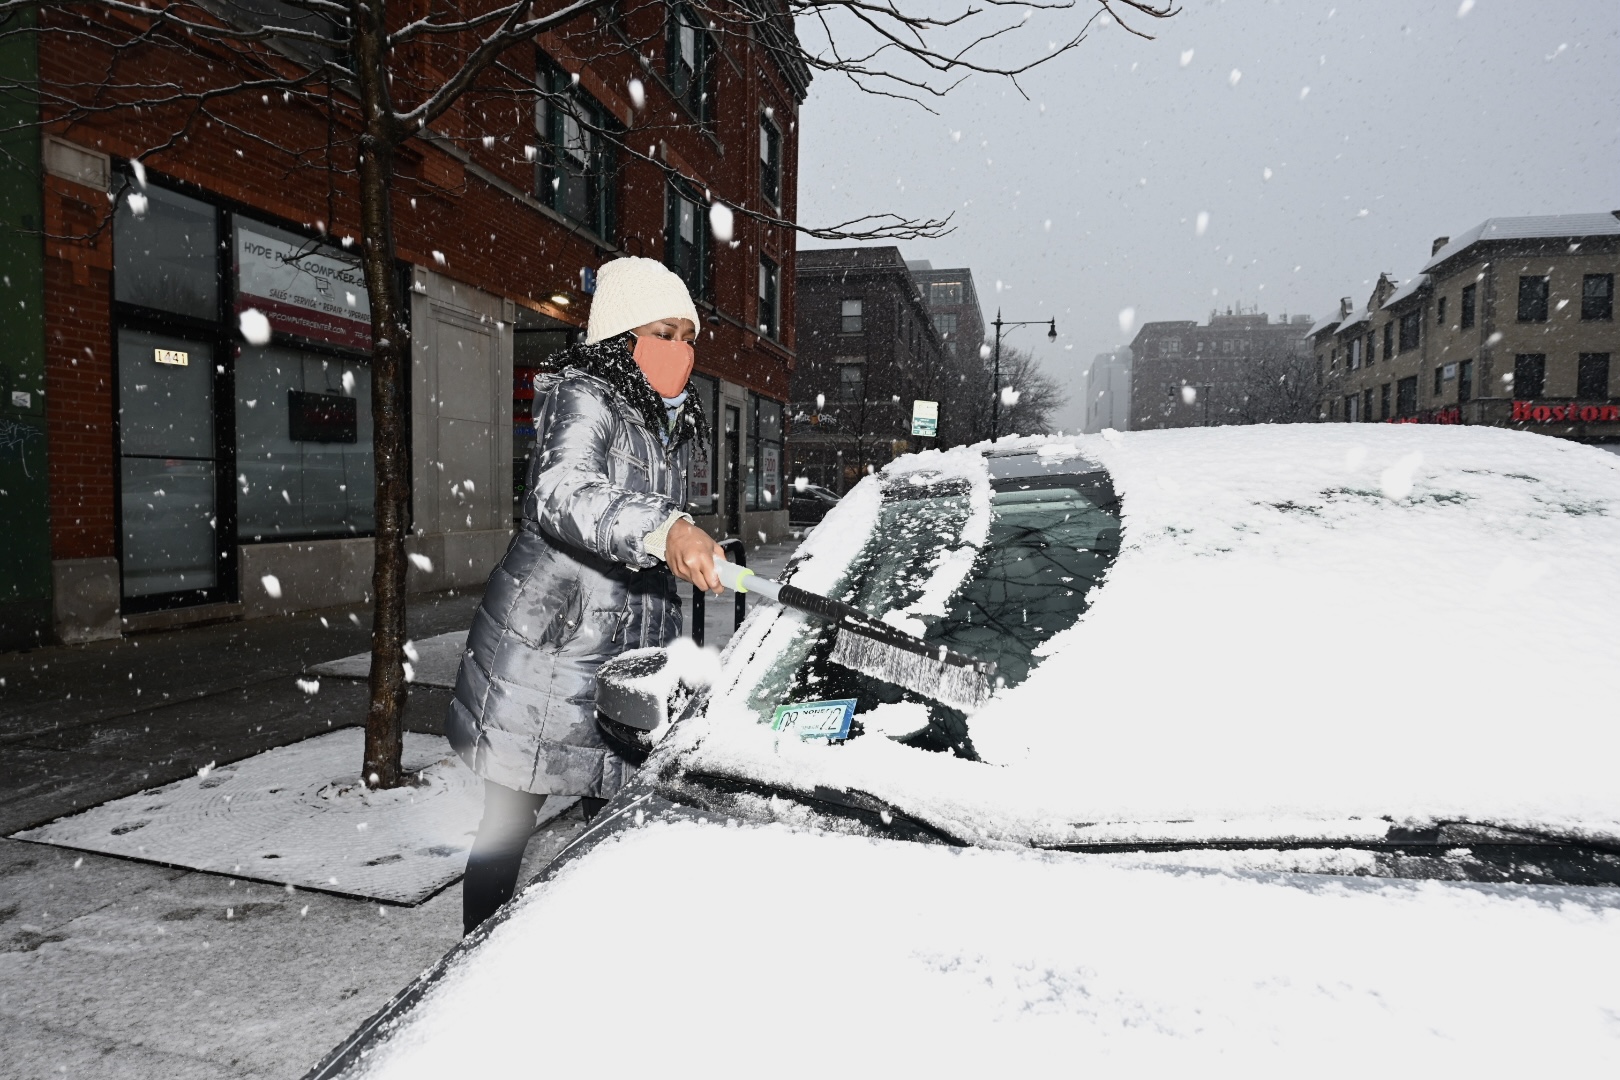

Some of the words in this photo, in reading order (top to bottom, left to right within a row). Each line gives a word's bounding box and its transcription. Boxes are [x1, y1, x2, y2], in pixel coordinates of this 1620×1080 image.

[244, 242, 272, 259] HYDE
[269, 288, 287, 300] SALES
[293, 295, 317, 308] SERVICE
[323, 302, 342, 315] REPAIR
[158, 350, 185, 364] 1441
[1511, 400, 1620, 421] Boston
